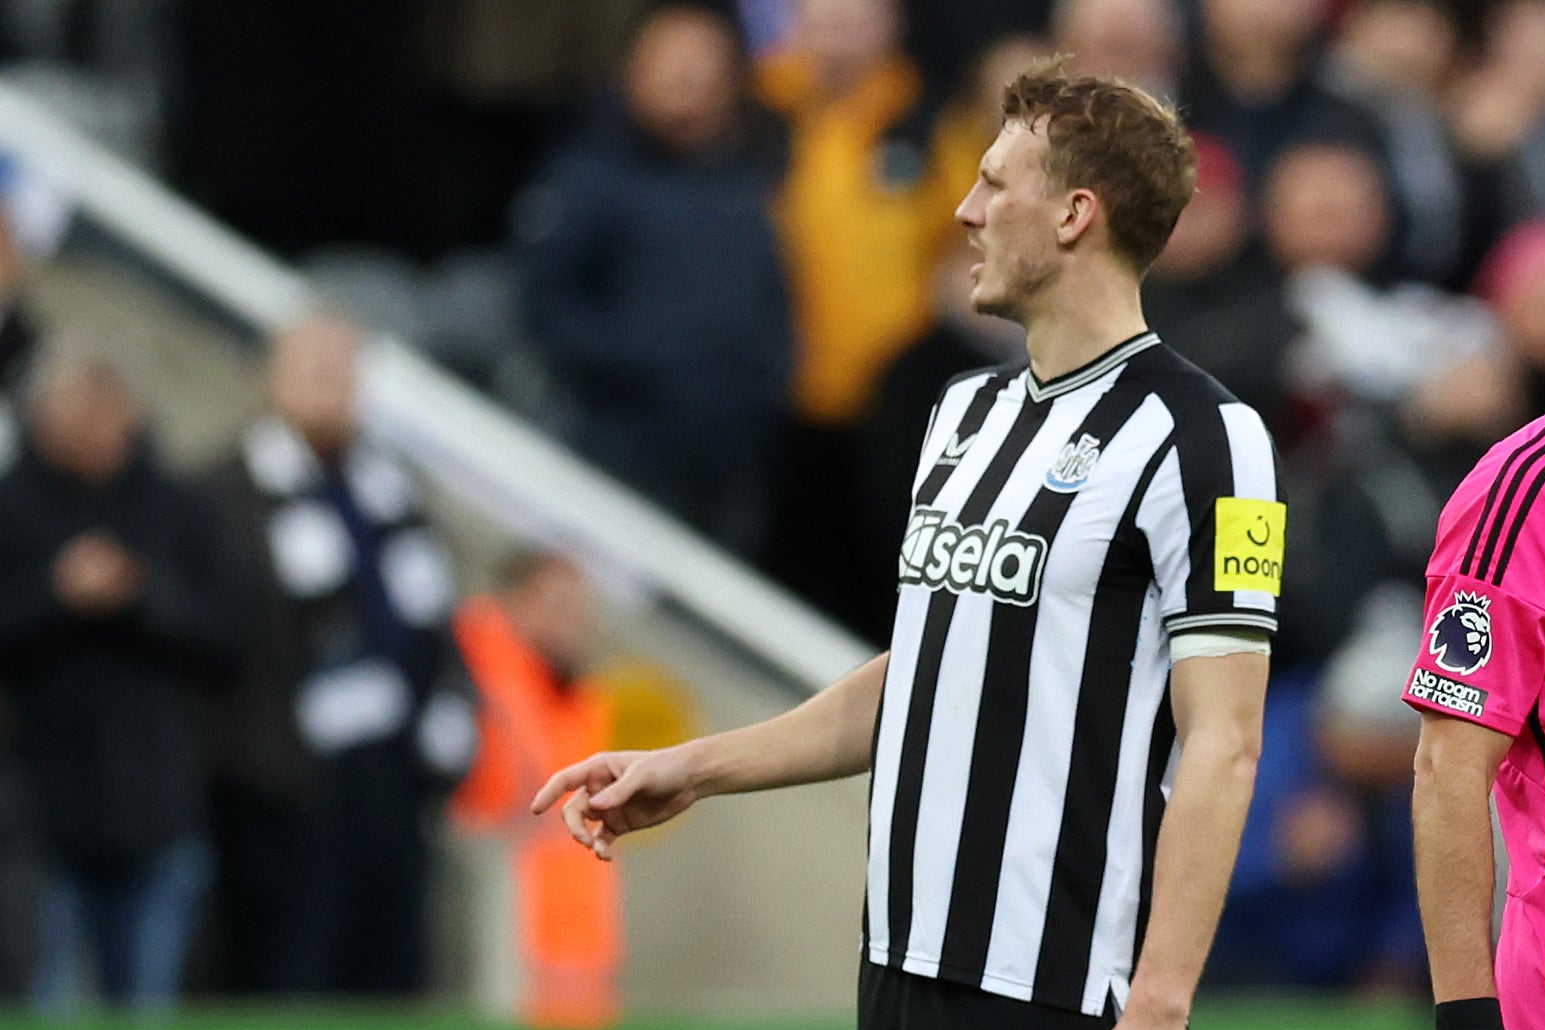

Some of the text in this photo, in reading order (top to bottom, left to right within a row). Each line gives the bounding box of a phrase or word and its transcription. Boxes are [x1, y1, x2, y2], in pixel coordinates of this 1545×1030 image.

[1223, 556, 1280, 580] noon
[1408, 682, 1483, 717] for racism
[1413, 668, 1480, 703] No room
